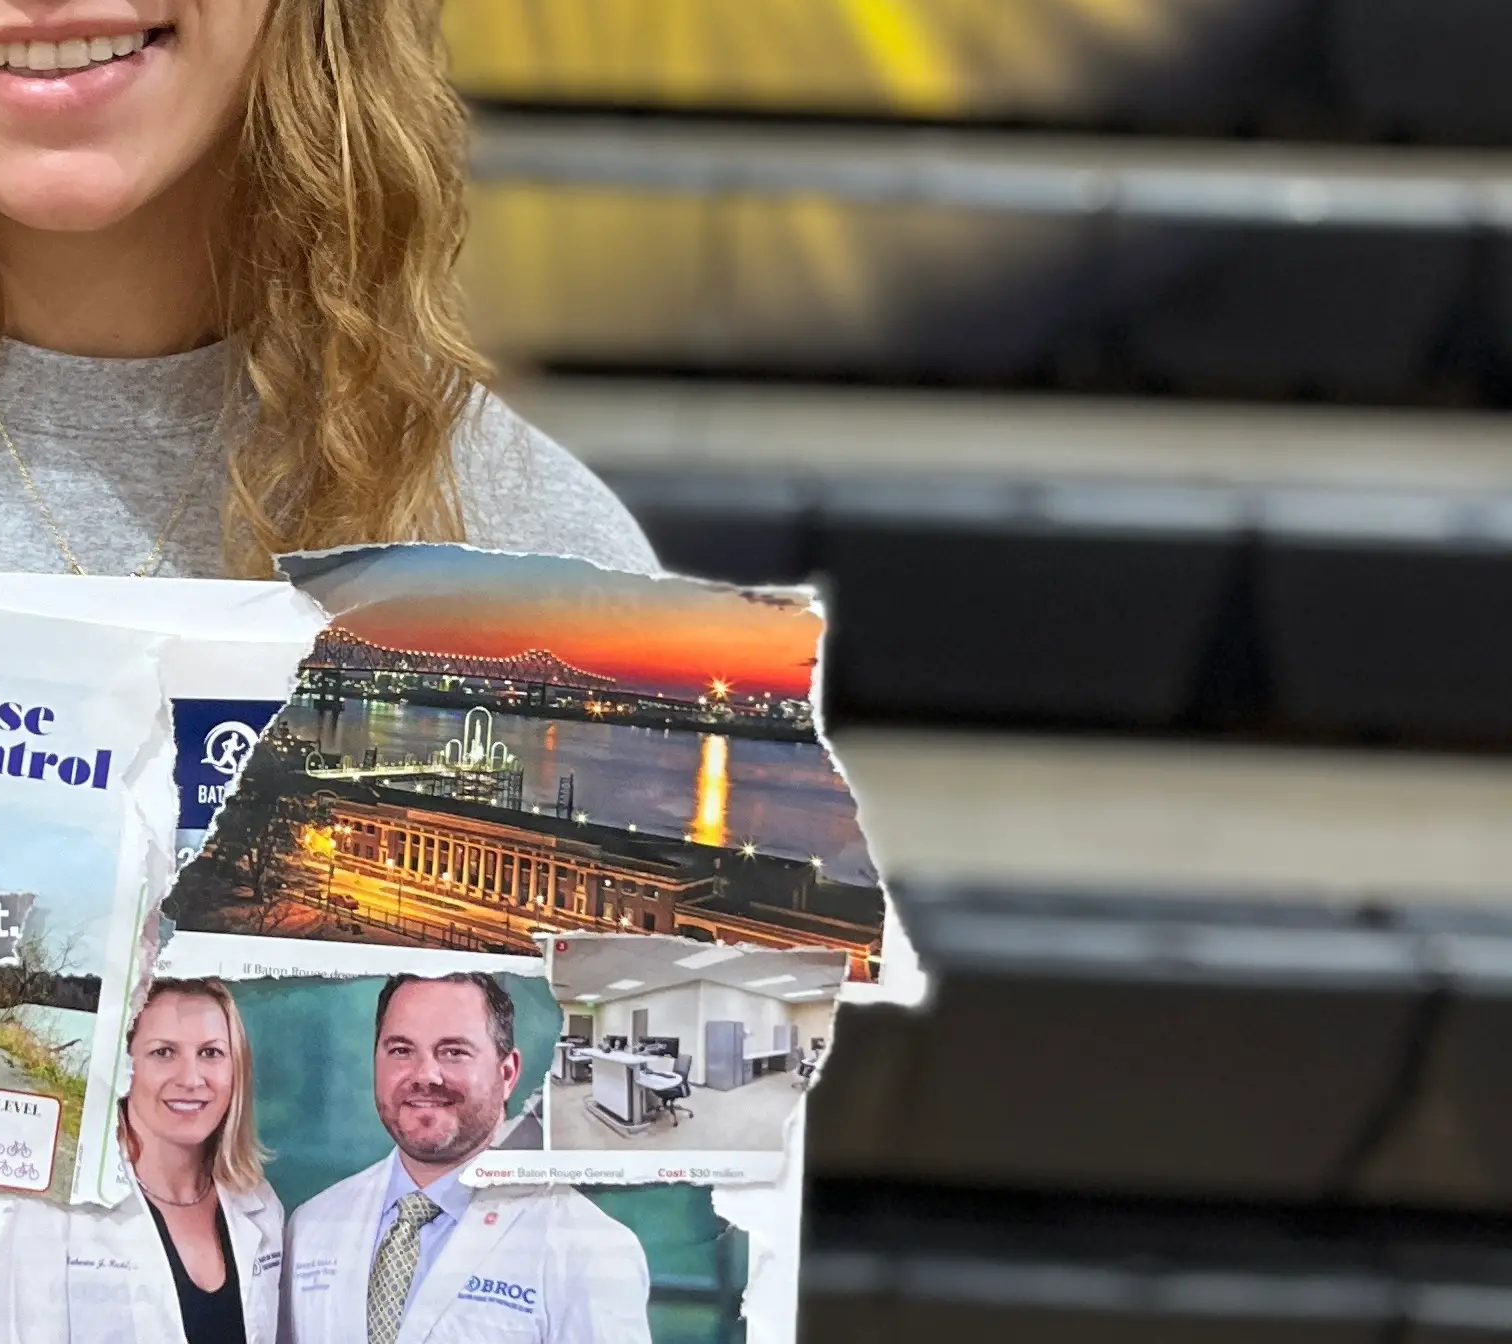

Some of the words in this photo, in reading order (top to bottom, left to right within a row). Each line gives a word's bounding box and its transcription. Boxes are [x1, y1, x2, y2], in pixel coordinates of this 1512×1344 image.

[476, 1167, 514, 1178] Owner:
[517, 1166, 547, 1178] Baton
[549, 1167, 582, 1180] Rouge
[584, 1167, 624, 1178] General
[658, 1167, 687, 1178] Cost:
[481, 1278, 536, 1305] BROC
